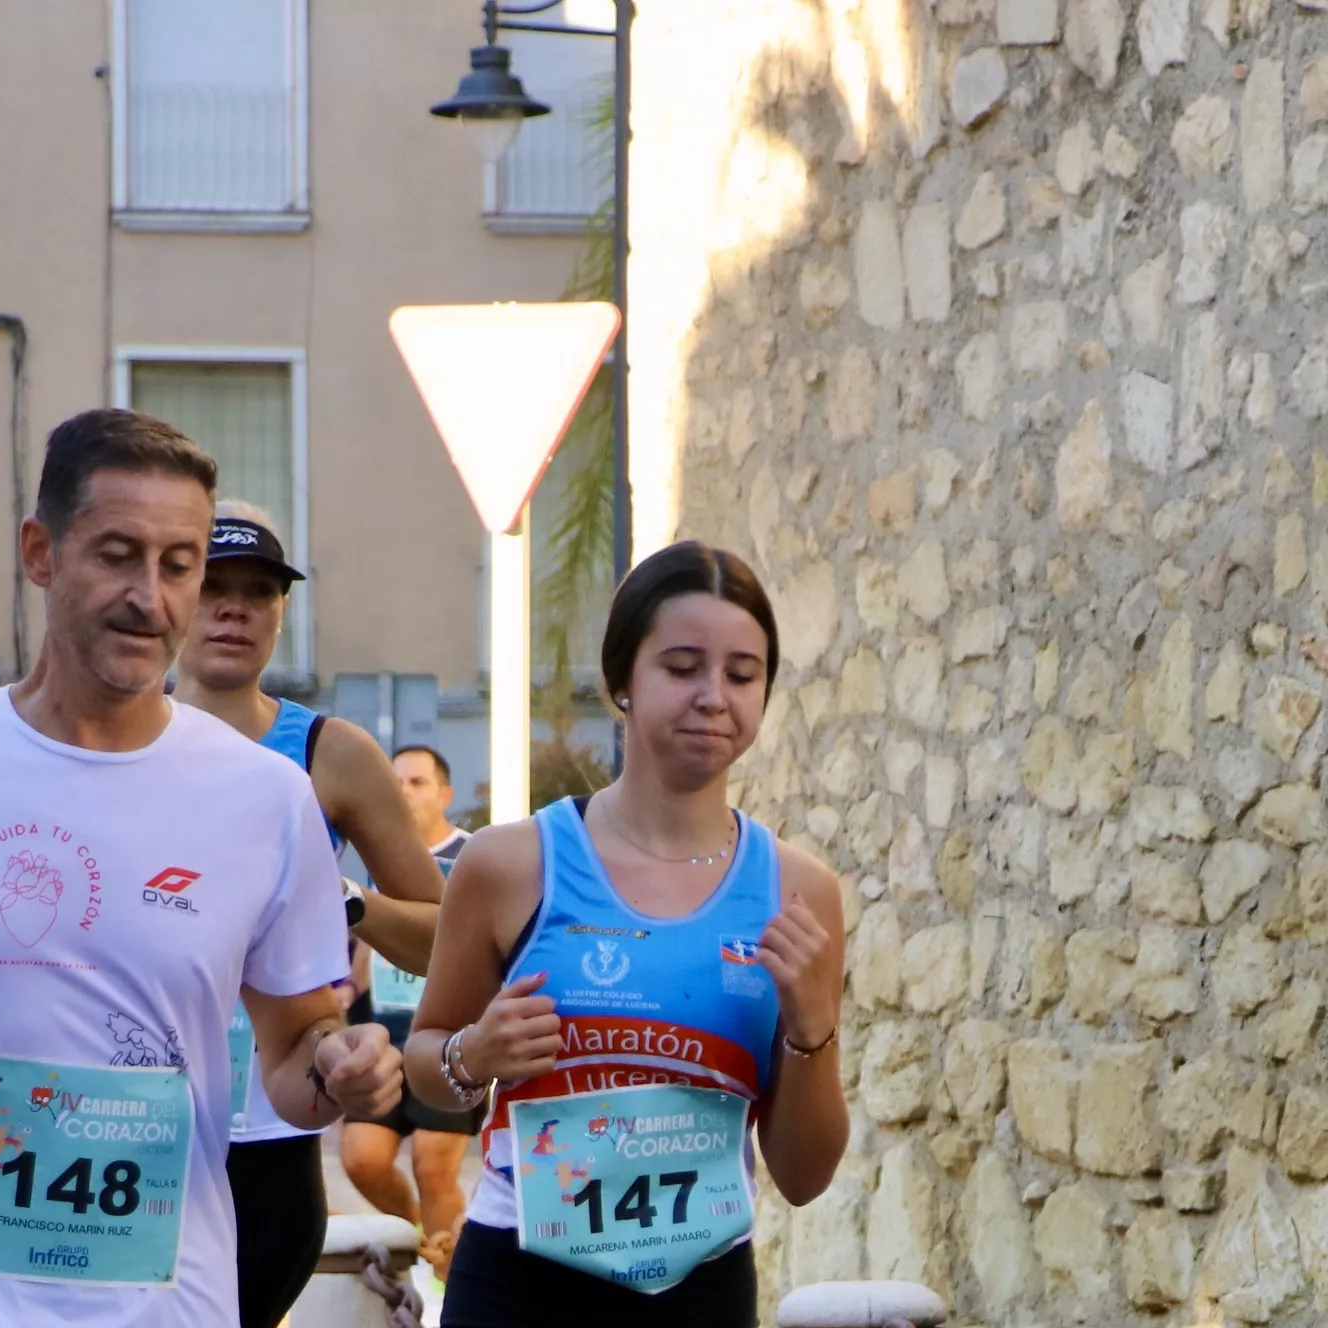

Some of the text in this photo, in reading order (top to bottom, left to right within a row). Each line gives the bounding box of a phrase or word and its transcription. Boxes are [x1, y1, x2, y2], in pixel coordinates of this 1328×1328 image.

[52, 825, 72, 843] TU
[562, 1022, 704, 1063] Maratón
[61, 1091, 85, 1112] IV
[80, 1097, 147, 1116] CARRERA
[617, 1117, 637, 1134] IV
[636, 1113, 695, 1134] CARRERA
[2, 1151, 141, 1217] 148
[146, 1179, 170, 1189] TALLA
[574, 1170, 698, 1234] 147
[68, 1223, 105, 1236] MARIN
[108, 1226, 133, 1236] RUIZ
[570, 1229, 712, 1256] MACARENA MARIN AMARO
[29, 1246, 89, 1268] Infrico
[635, 1258, 666, 1269] GRUPO
